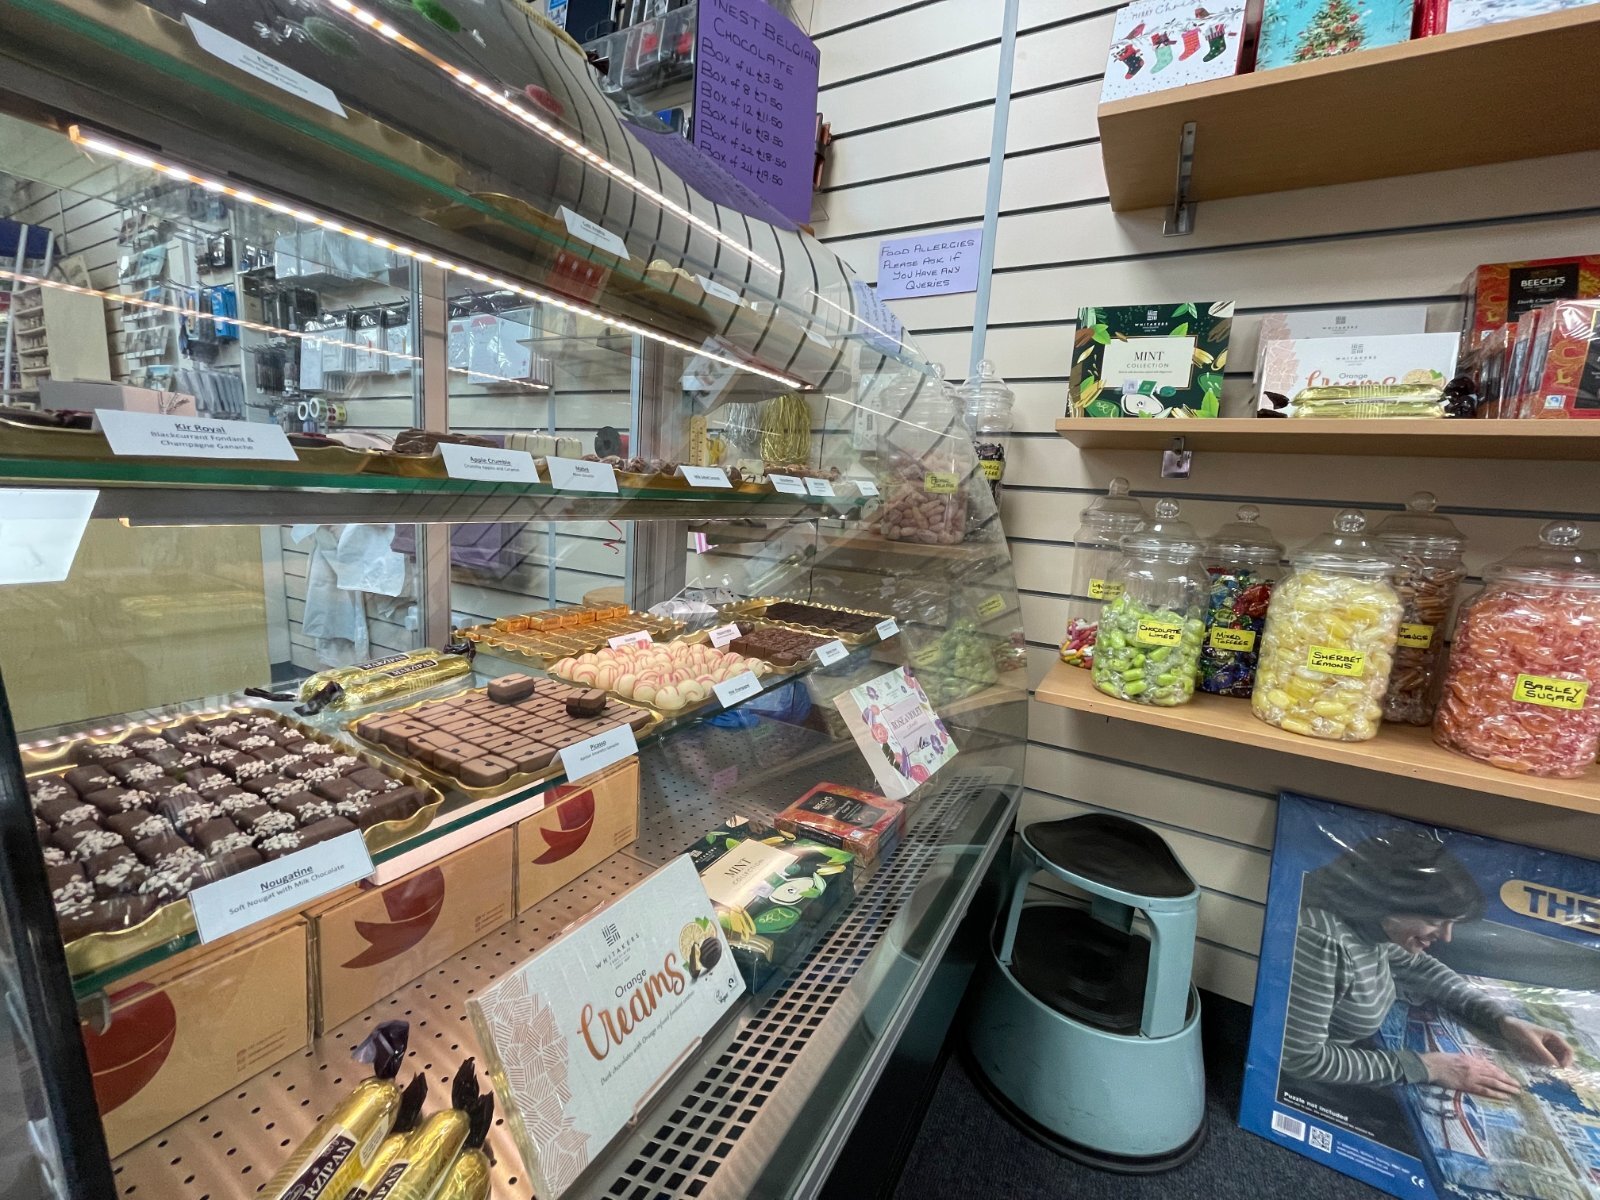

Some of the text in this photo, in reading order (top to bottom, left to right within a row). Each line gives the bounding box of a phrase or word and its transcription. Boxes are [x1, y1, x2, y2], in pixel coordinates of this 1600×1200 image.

[713, 0, 818, 68] INEST BELGIAN
[713, 17, 795, 75] CHOCOLATE
[745, 66, 755, 77] 4
[743, 83, 751, 96] 8
[742, 104, 754, 116] 12
[741, 121, 752, 135] 16
[741, 144, 755, 156] 22
[741, 161, 754, 177] 24
[881, 239, 975, 257] FOOD ALLERGIES
[883, 260, 918, 269] PLEASE
[923, 257, 944, 265] ASK
[893, 266, 961, 280] YOU HAVE ANY
[1134, 351, 1165, 361] MINT
[174, 423, 226, 434] Kir Royal
[150, 431, 208, 441] Blackcurrant
[210, 434, 241, 442] Fondant
[160, 440, 215, 450] Champagne
[470, 456, 488, 464] Apple
[1140, 624, 1181, 635] CHOCOLATE
[1217, 632, 1240, 640] MIXED
[1216, 638, 1248, 646] TOFFEES
[364, 655, 407, 670] MARZIPAN
[1312, 659, 1353, 670] LEMONS
[1313, 652, 1362, 663] SHERBET
[392, 661, 435, 676] MARZIPAN
[1524, 680, 1582, 697] BARLEY
[1525, 690, 1577, 703] SUGAR
[724, 857, 751, 877] MINT
[260, 865, 313, 892] Nougatine
[229, 864, 345, 915] Soft Nougat with Milk Chocolate
[1523, 885, 1600, 929] THE
[595, 933, 640, 969] WHITAKERS
[614, 968, 647, 998] Orange
[577, 953, 685, 1061] Creams
[633, 1041, 642, 1053] with
[641, 1028, 657, 1044] Orange
[1284, 1092, 1349, 1121] Puzzle not included
[303, 1142, 353, 1200] RZIPAN
